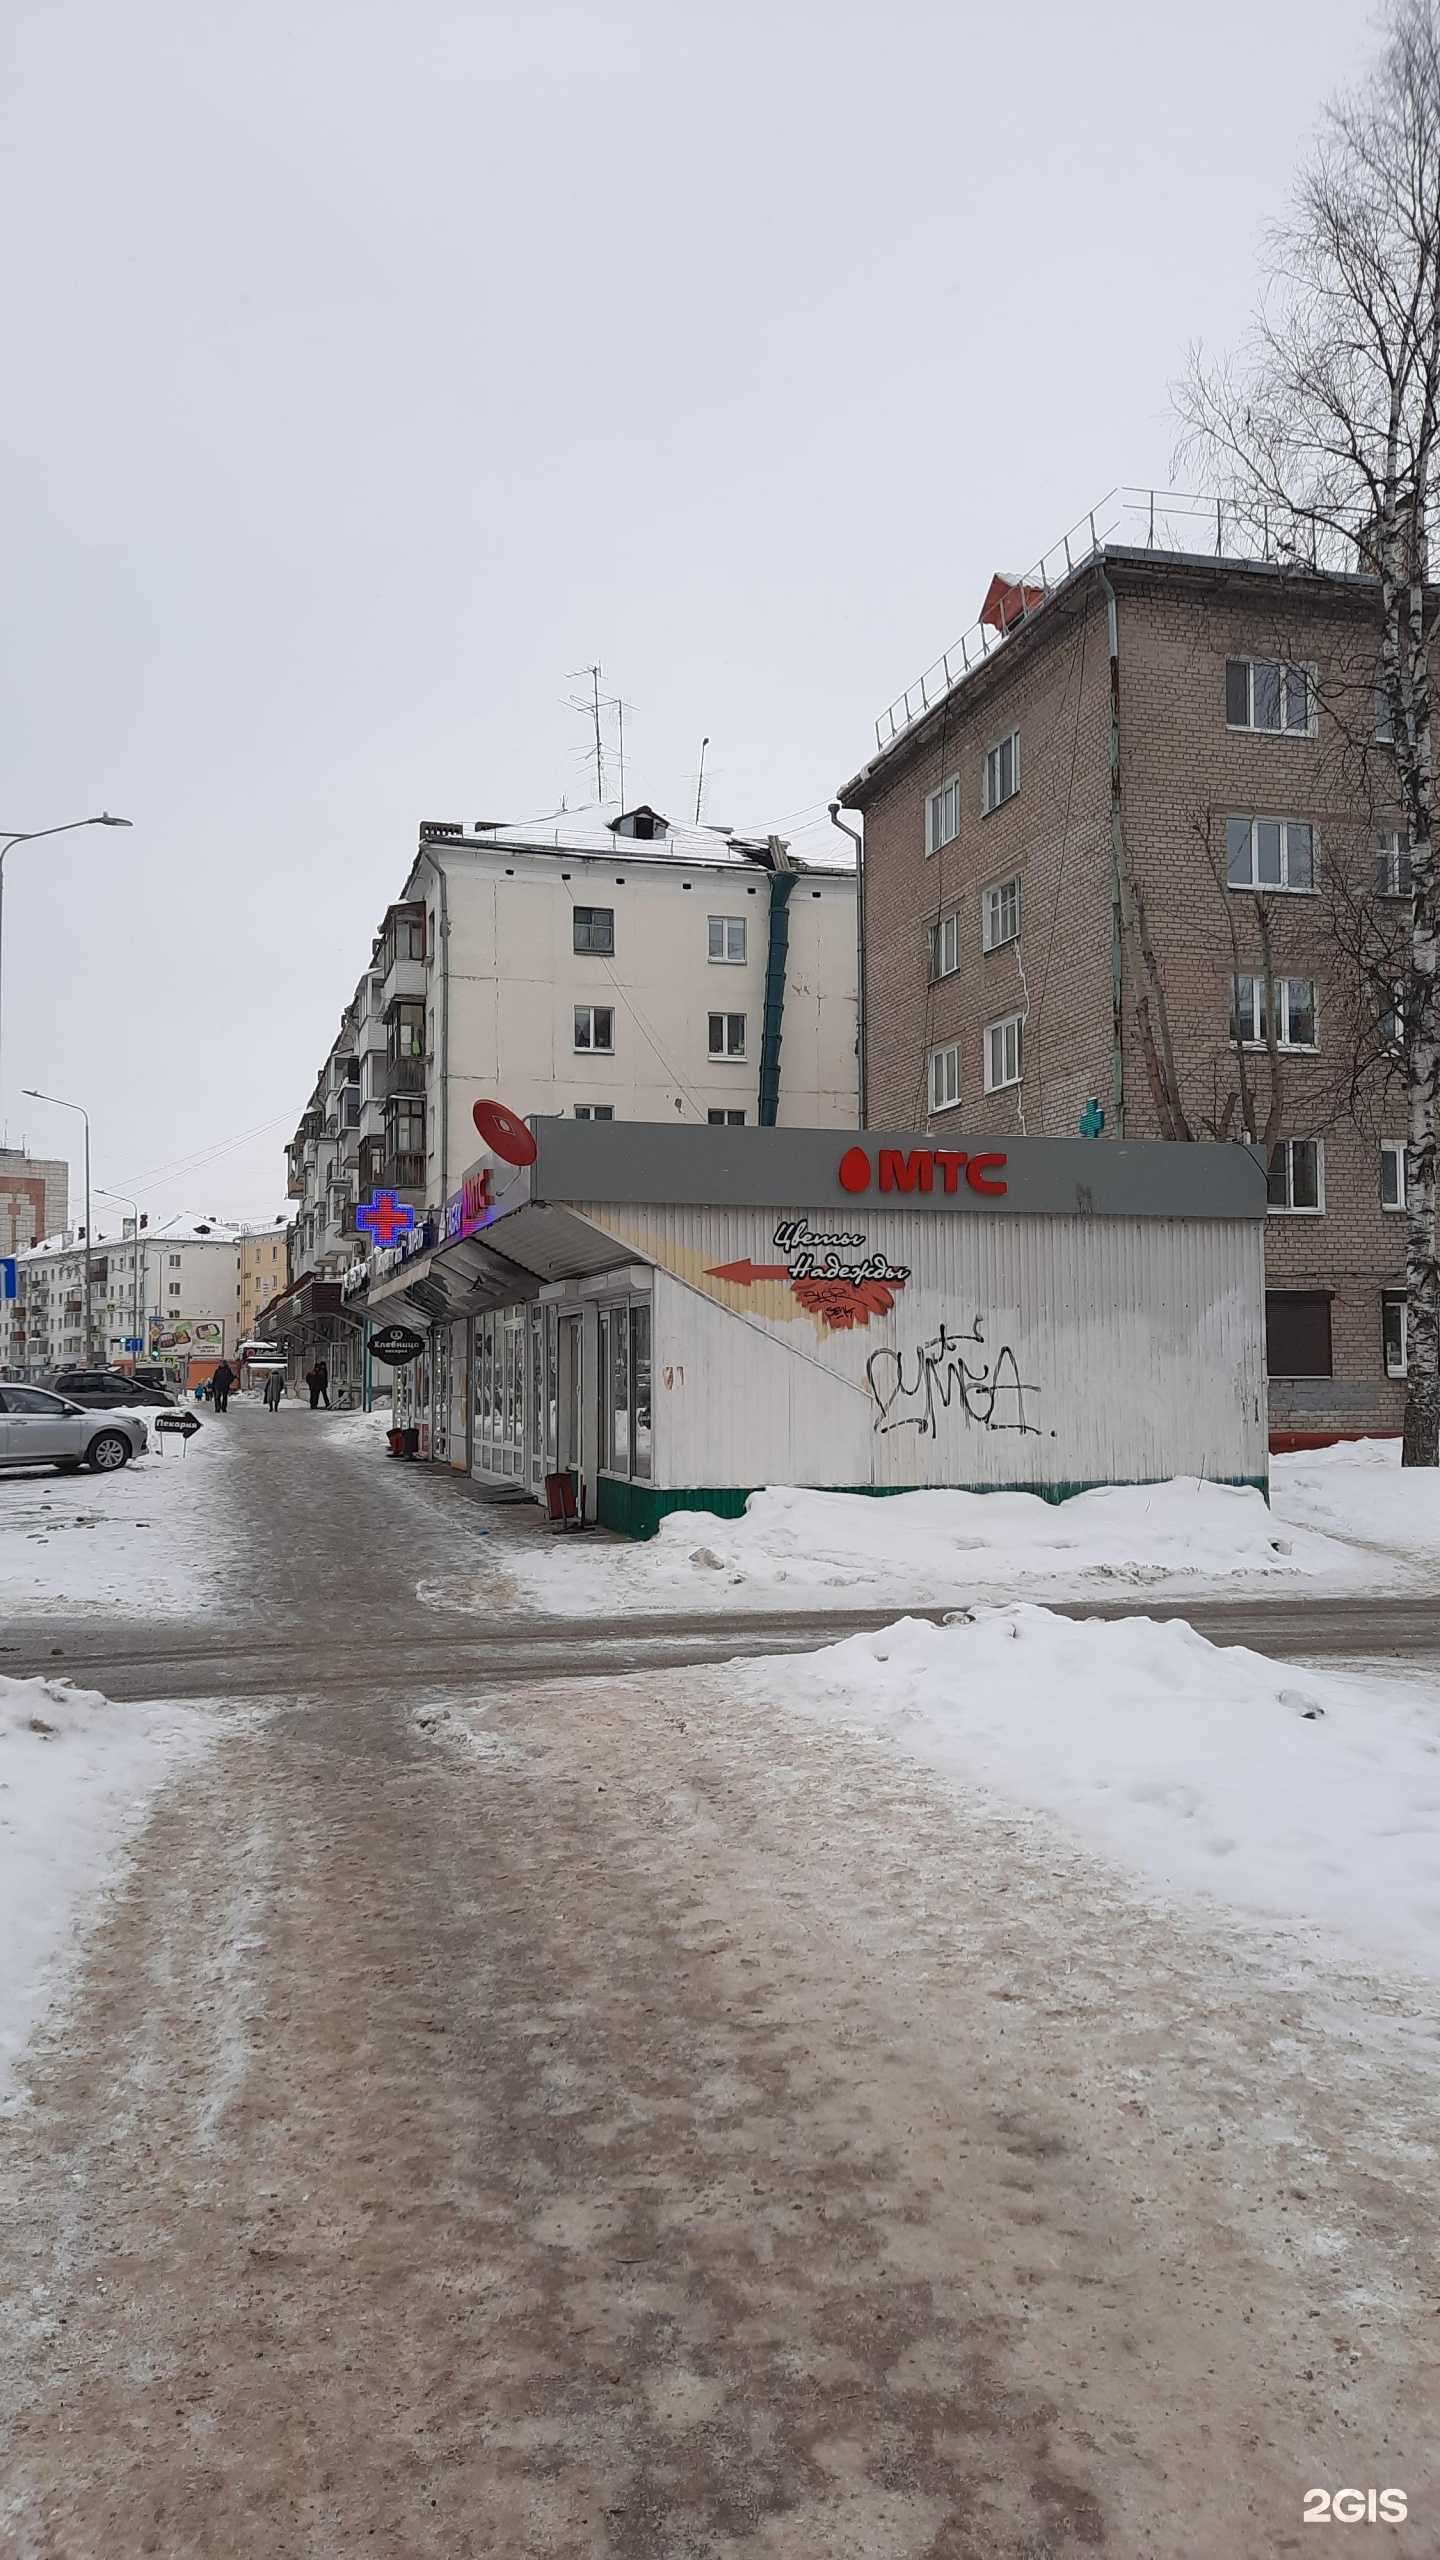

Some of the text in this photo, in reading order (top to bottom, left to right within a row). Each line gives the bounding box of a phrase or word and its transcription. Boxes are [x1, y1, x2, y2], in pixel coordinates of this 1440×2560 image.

[879, 1149, 1008, 1196] МТС
[775, 1220, 866, 1253] Цветы
[788, 1253, 911, 1286] Надежды
[156, 1418, 198, 1430] Пекарня
